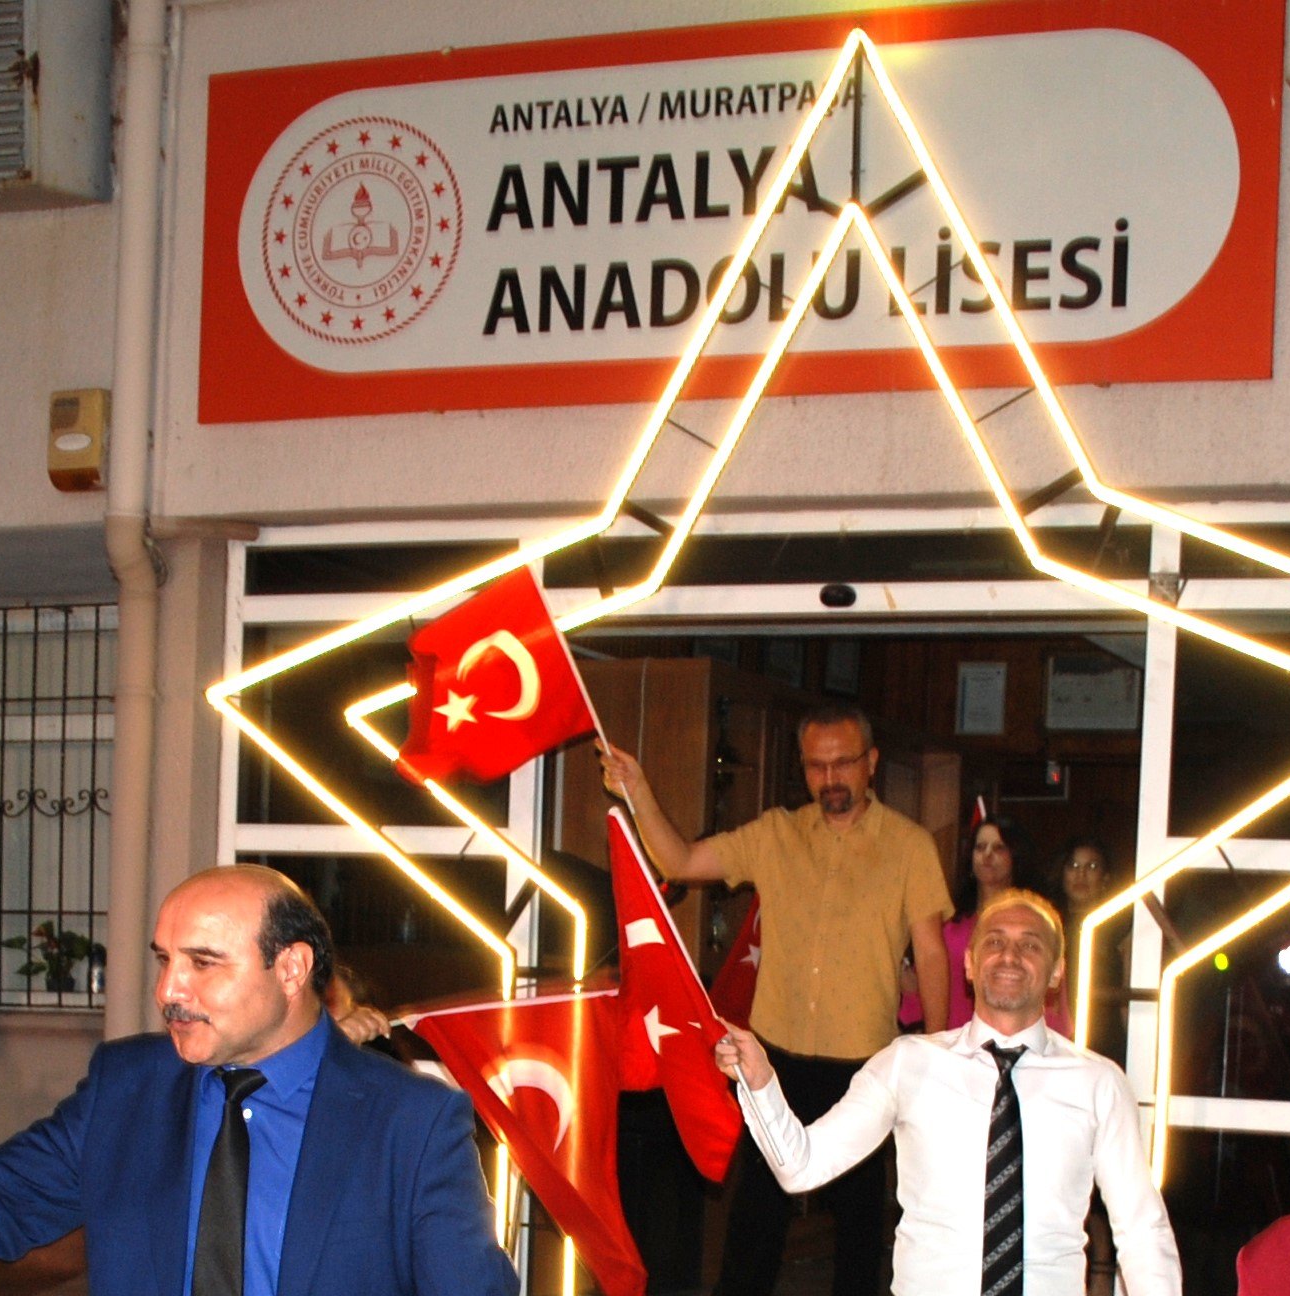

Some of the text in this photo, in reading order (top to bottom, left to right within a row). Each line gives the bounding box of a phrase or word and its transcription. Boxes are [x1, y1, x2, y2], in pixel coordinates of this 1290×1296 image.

[489, 77, 866, 134] ANTALYA / MURATPAA
[486, 145, 826, 232] ANTALYA
[482, 217, 1129, 336] ANADOLU LİSESİ
